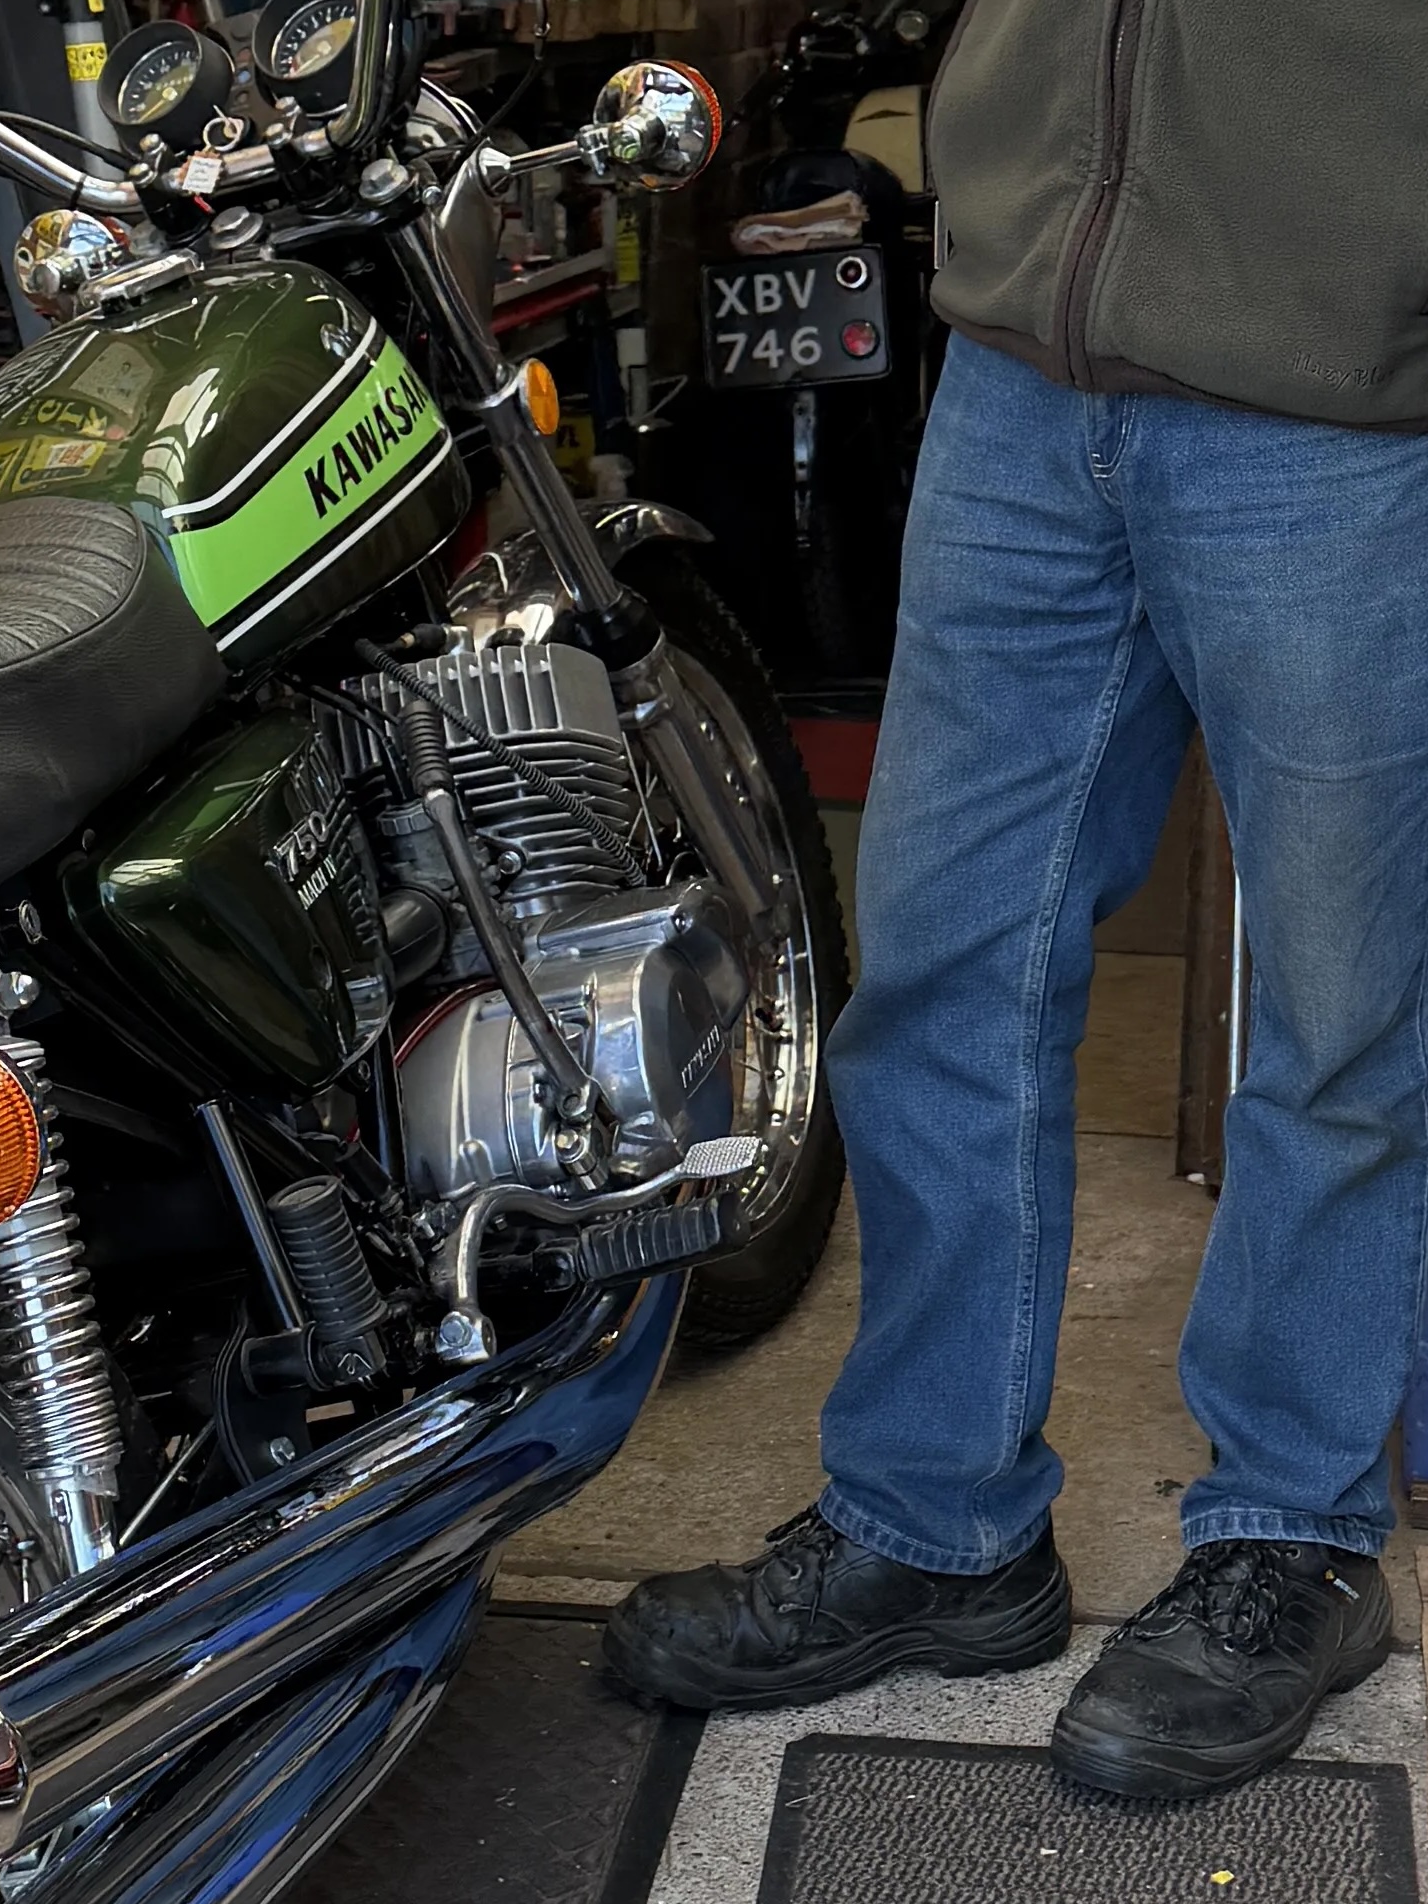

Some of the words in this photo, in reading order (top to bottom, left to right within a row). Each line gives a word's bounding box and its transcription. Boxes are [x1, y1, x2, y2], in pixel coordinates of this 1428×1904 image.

[714, 268, 816, 319] XBV
[716, 325, 822, 374] 746
[304, 367, 429, 520] KAWASAK
[273, 810, 330, 882] 750
[297, 866, 330, 911] MACH
